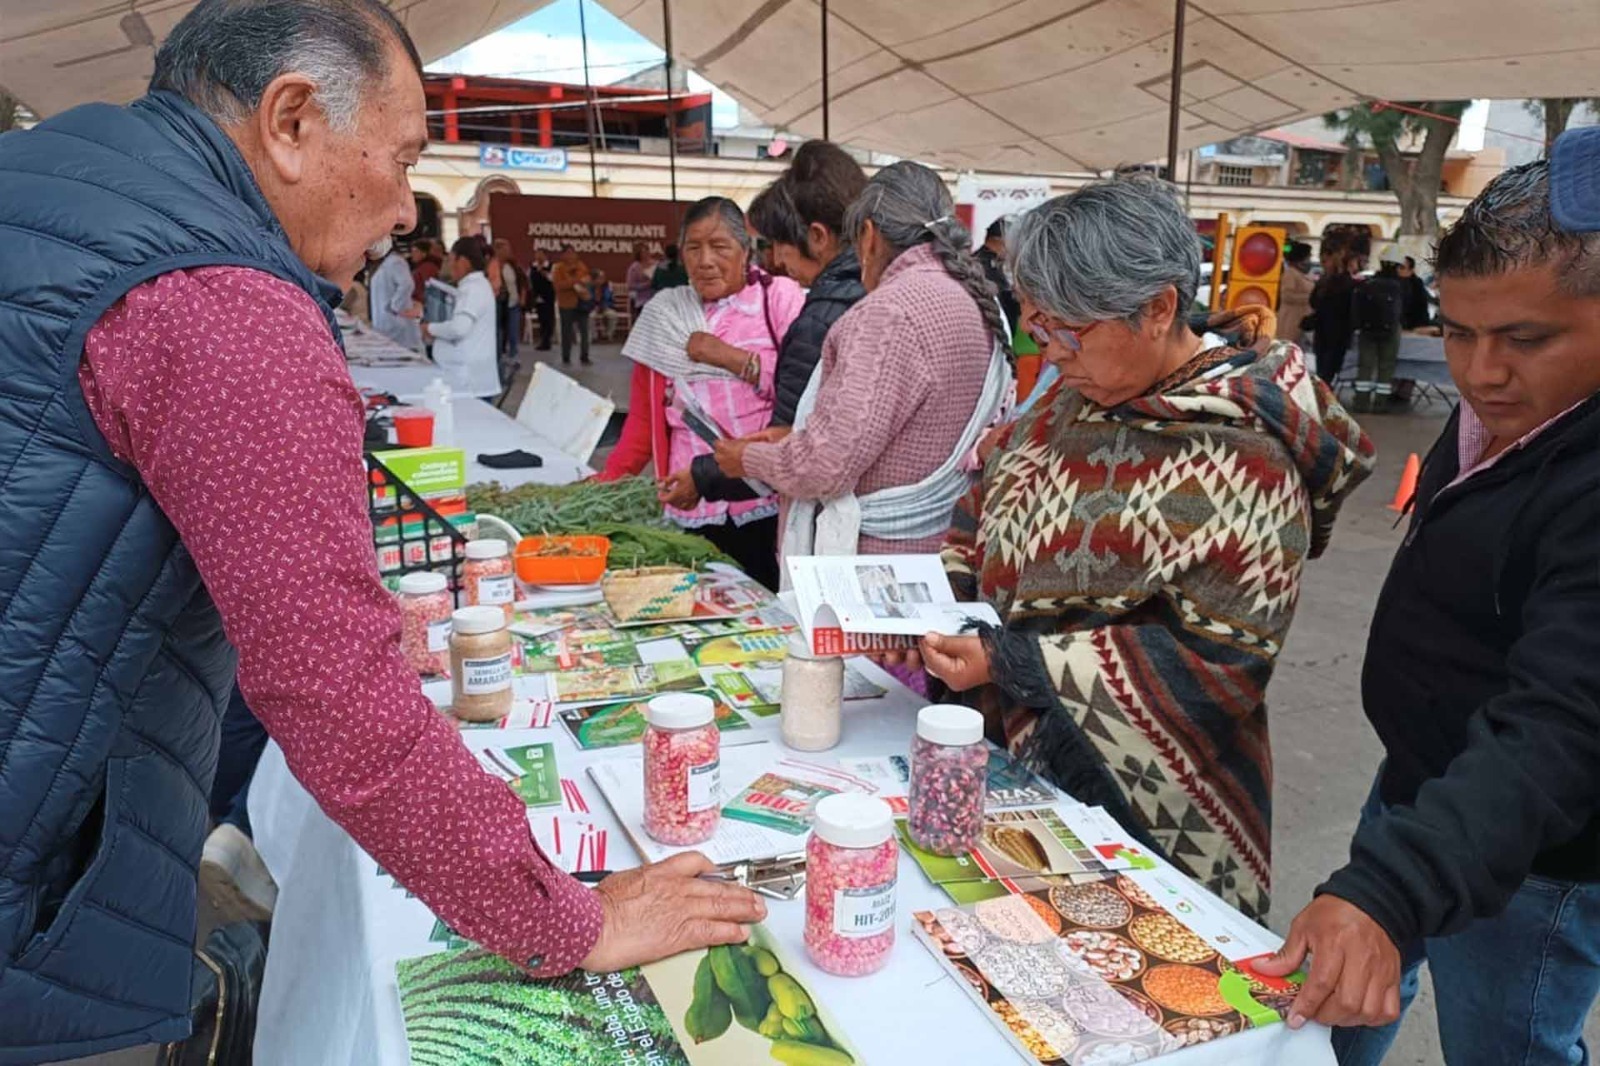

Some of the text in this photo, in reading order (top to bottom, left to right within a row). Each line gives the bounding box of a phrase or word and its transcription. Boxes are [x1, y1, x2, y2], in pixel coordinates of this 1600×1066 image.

[528, 223, 666, 238] JORNADA ITINERANTE
[606, 972, 624, 988] de
[592, 986, 613, 1010] una
[614, 989, 647, 1033] Estado
[605, 1013, 630, 1047] haba
[630, 1033, 653, 1048] el
